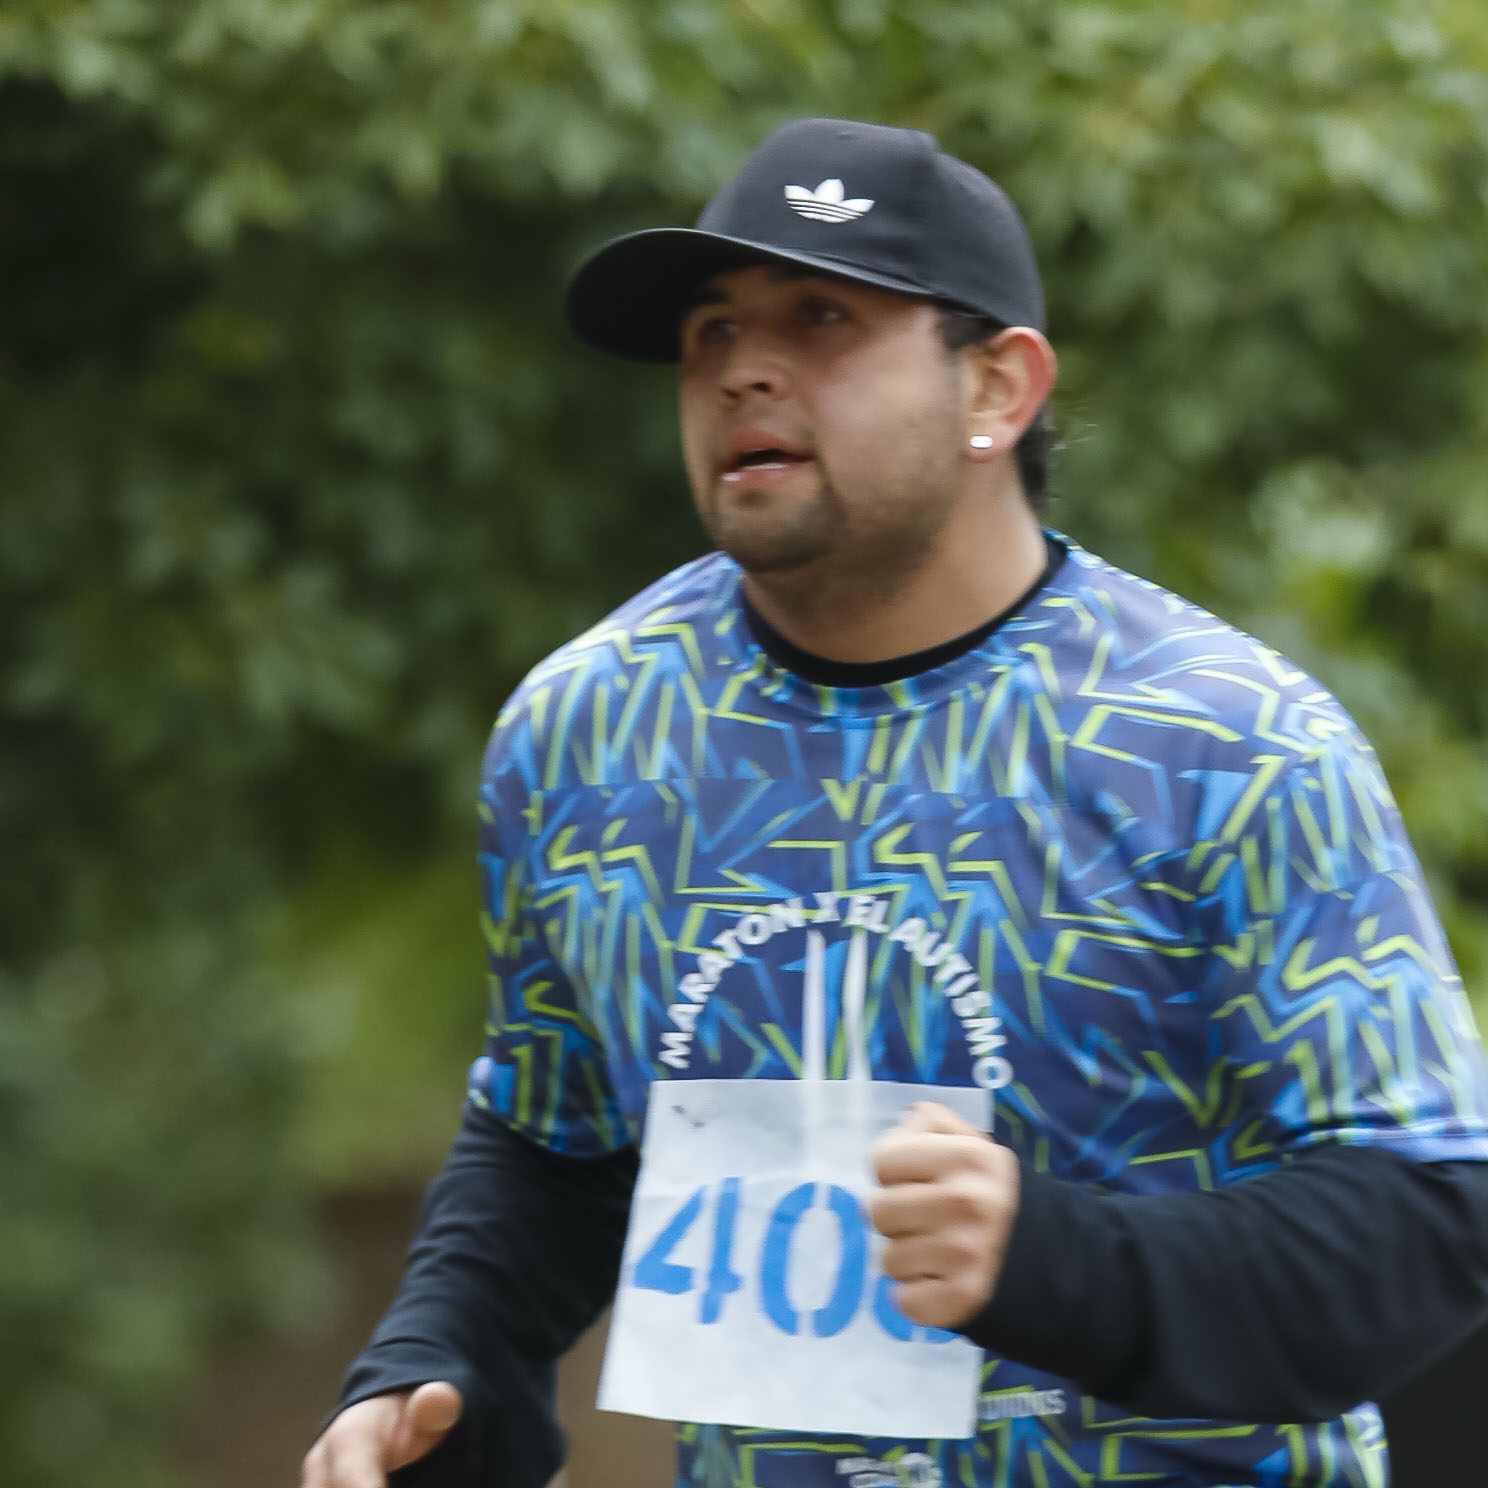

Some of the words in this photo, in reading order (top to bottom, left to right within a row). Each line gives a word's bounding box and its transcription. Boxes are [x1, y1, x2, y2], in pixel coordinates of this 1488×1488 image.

[658, 896, 806, 1069] MARATON
[812, 890, 841, 923] X
[846, 893, 890, 934] EL
[888, 916, 1014, 1089] AUTISMO
